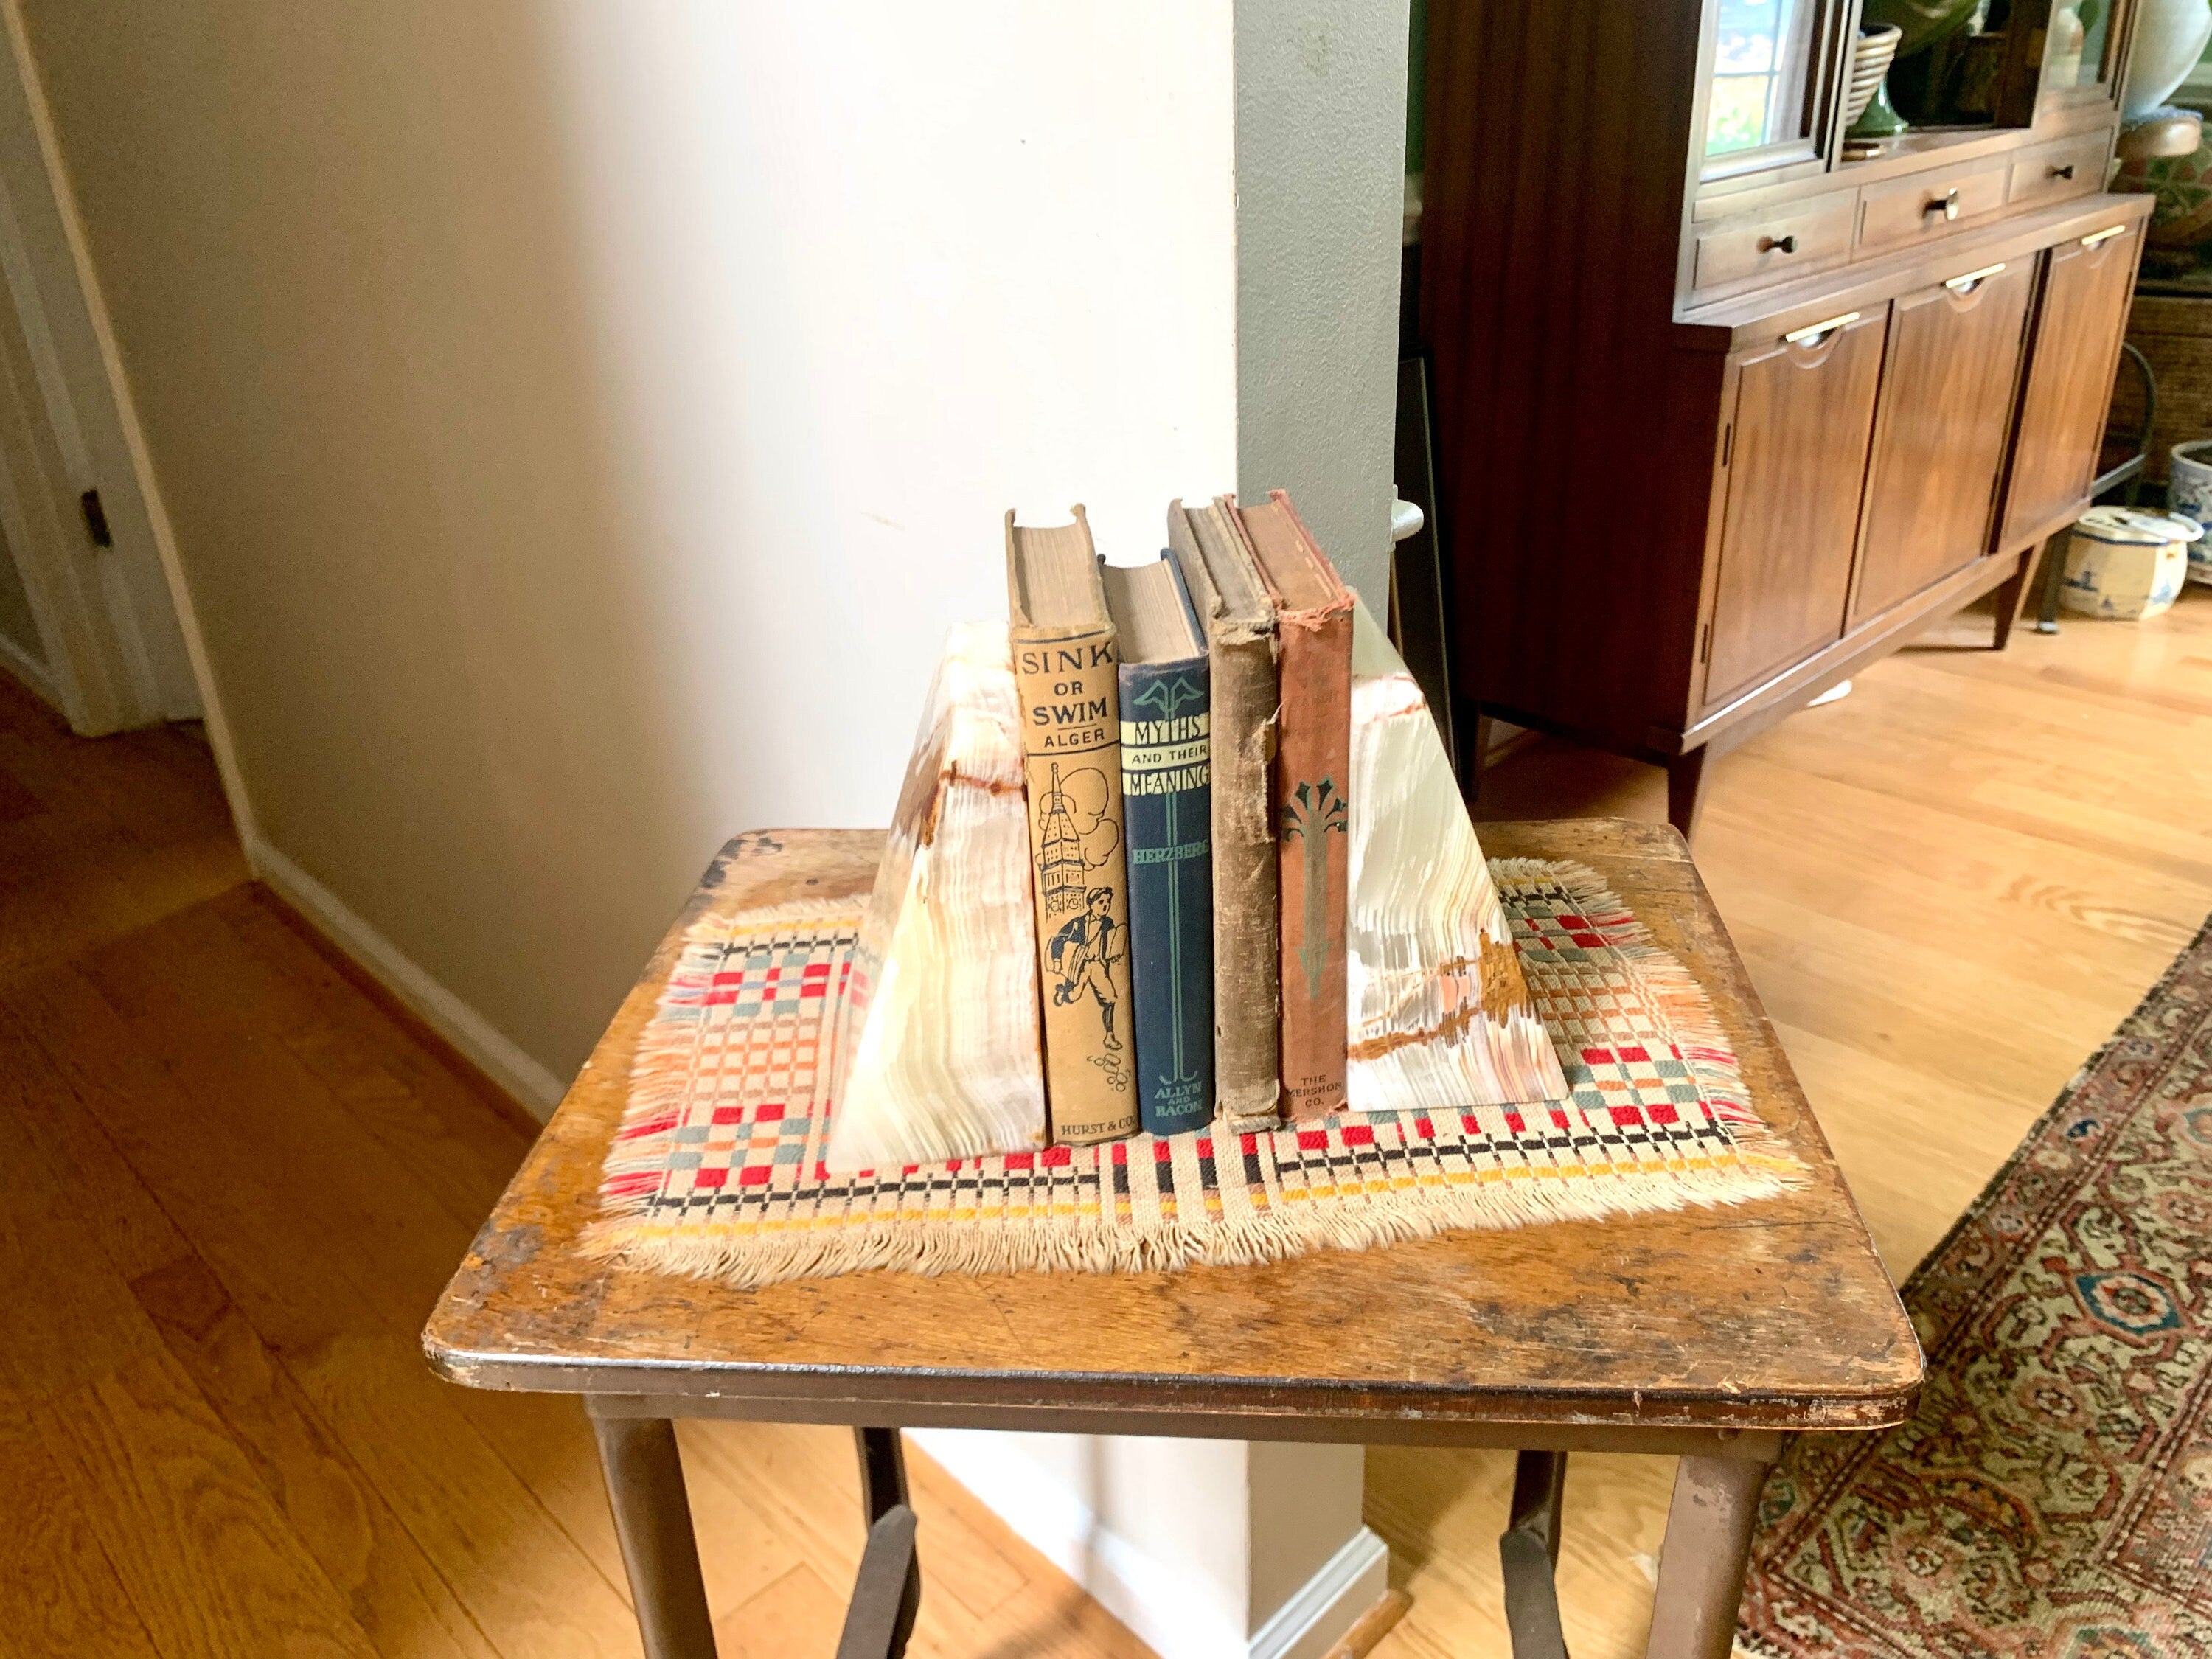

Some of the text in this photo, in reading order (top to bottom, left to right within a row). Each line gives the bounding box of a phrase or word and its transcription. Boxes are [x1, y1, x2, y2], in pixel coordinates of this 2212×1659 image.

[1023, 641, 1113, 675] SINK
[1054, 681, 1084, 696] OR
[1032, 696, 1108, 726] SWIM
[1044, 728, 1105, 748] ALGER
[1135, 715, 1200, 745] MYTHS
[1132, 745, 1207, 764] AND THEIR
[1131, 765, 1208, 796] MEANING
[1132, 839, 1208, 865] HERZBERG
[1301, 1074, 1326, 1085] THE
[1154, 1081, 1202, 1099] ALLYN
[1155, 1099, 1203, 1117] BACON
[1167, 1096, 1191, 1105] AND
[1304, 1097, 1324, 1107] CO.
[1061, 1123, 1105, 1135] HURST
[1107, 1121, 1116, 1131] &
